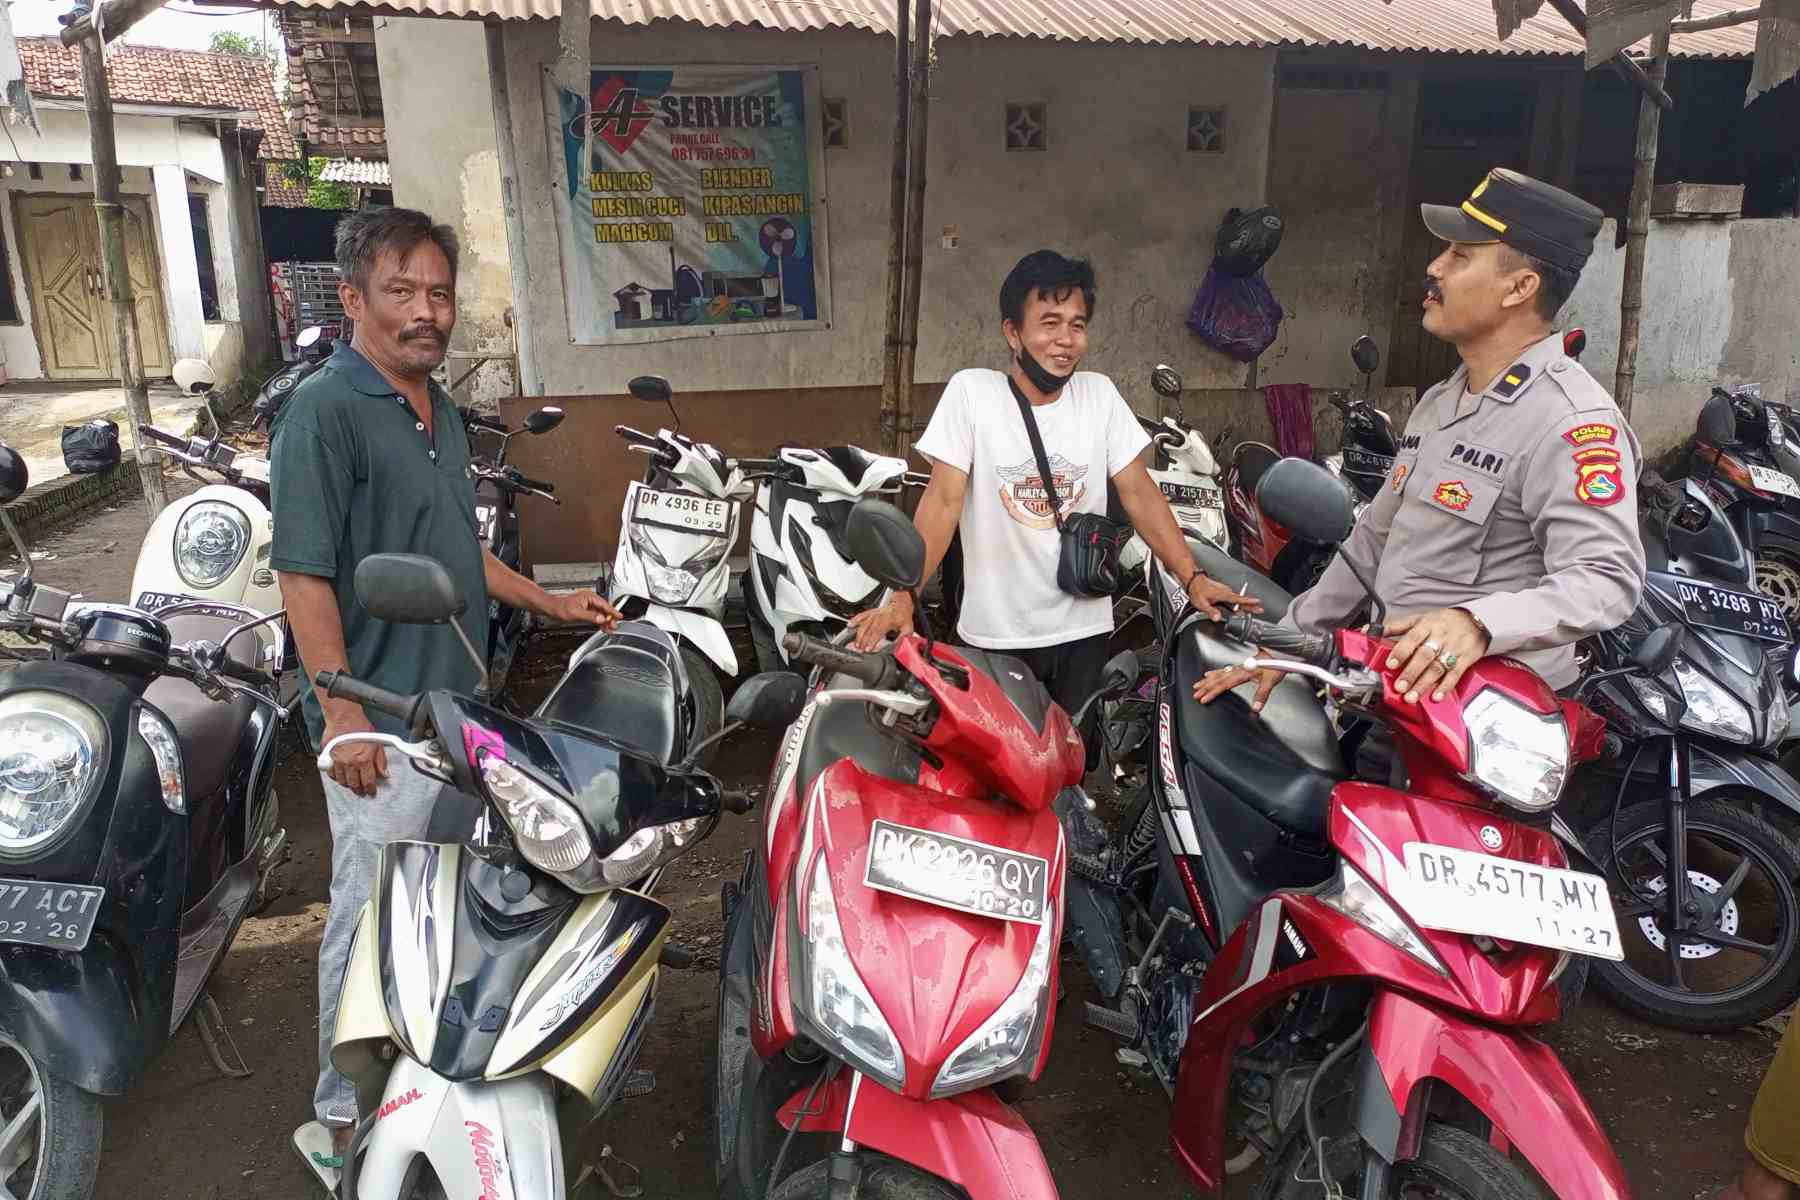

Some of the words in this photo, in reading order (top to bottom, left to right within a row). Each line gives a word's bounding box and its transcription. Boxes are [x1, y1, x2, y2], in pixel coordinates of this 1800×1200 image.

[659, 95, 778, 129] SERVICE
[591, 171, 653, 191] KULKAS
[701, 168, 773, 189] BLENDER
[592, 197, 643, 217] MESIN
[645, 197, 687, 217] CUCI
[703, 195, 752, 217] KIPAS
[753, 193, 805, 216] ANGIN
[1449, 443, 1504, 475] POLRI
[1162, 483, 1177, 497] DR
[641, 491, 659, 506] DR
[664, 496, 700, 512] 4936
[704, 502, 722, 516] EE
[143, 592, 164, 607] DR
[1680, 584, 1703, 604] DK
[1708, 589, 1751, 614] 3288
[1758, 599, 1782, 620] HZ
[1159, 702, 1178, 785] VEGA
[875, 828, 917, 866] DK
[1000, 858, 1040, 894] QY
[1418, 852, 1458, 887] DR
[1476, 862, 1545, 903] 4577
[1559, 877, 1599, 912] MY
[35, 888, 98, 914] ACT
[1283, 919, 1306, 958] YAMAHA
